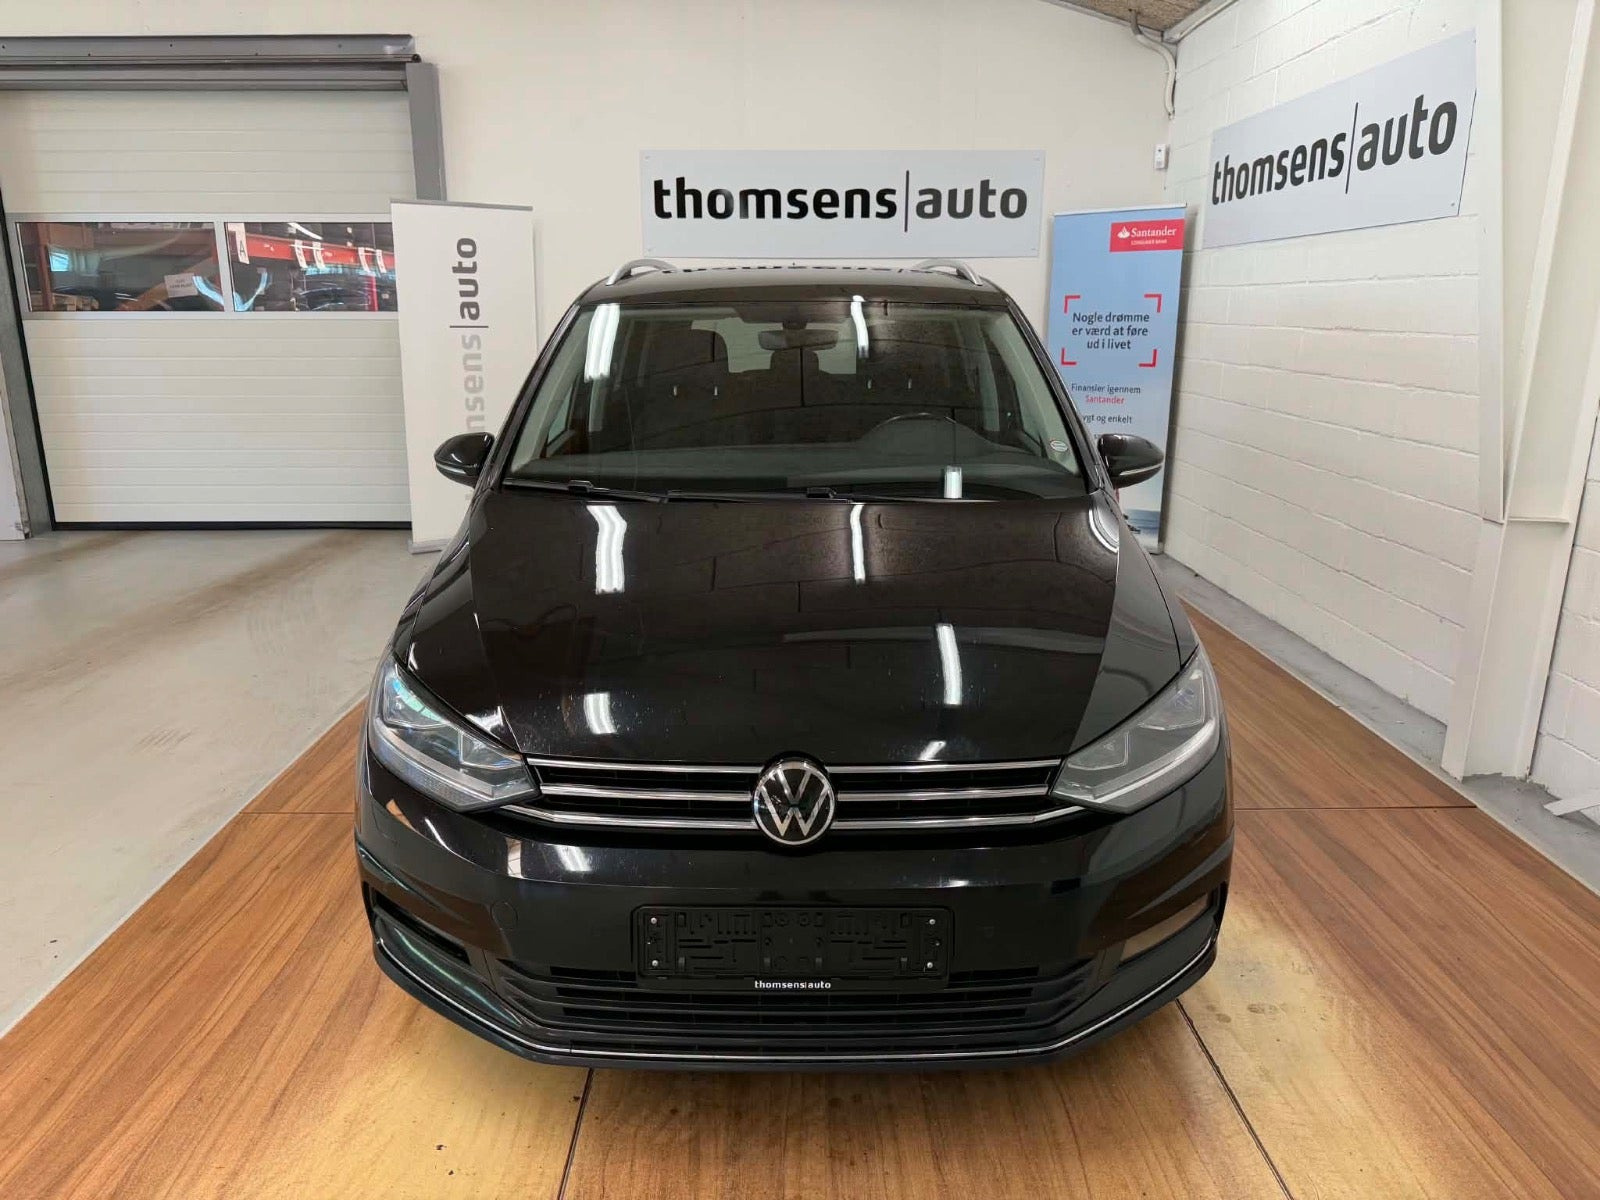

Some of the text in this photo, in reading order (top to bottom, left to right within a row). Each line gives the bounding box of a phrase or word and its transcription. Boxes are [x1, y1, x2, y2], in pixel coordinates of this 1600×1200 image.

[1131, 226, 1177, 238] Santander
[1072, 312, 1150, 325] Nogle drømme
[1072, 325, 1149, 336] er værd at føre
[1087, 338, 1100, 349] ud
[1107, 338, 1131, 350] livet
[1071, 383, 1141, 394] Finansier igennem
[1086, 395, 1125, 404] Santander
[1096, 416, 1106, 424] og
[1107, 415, 1132, 424] enkelt
